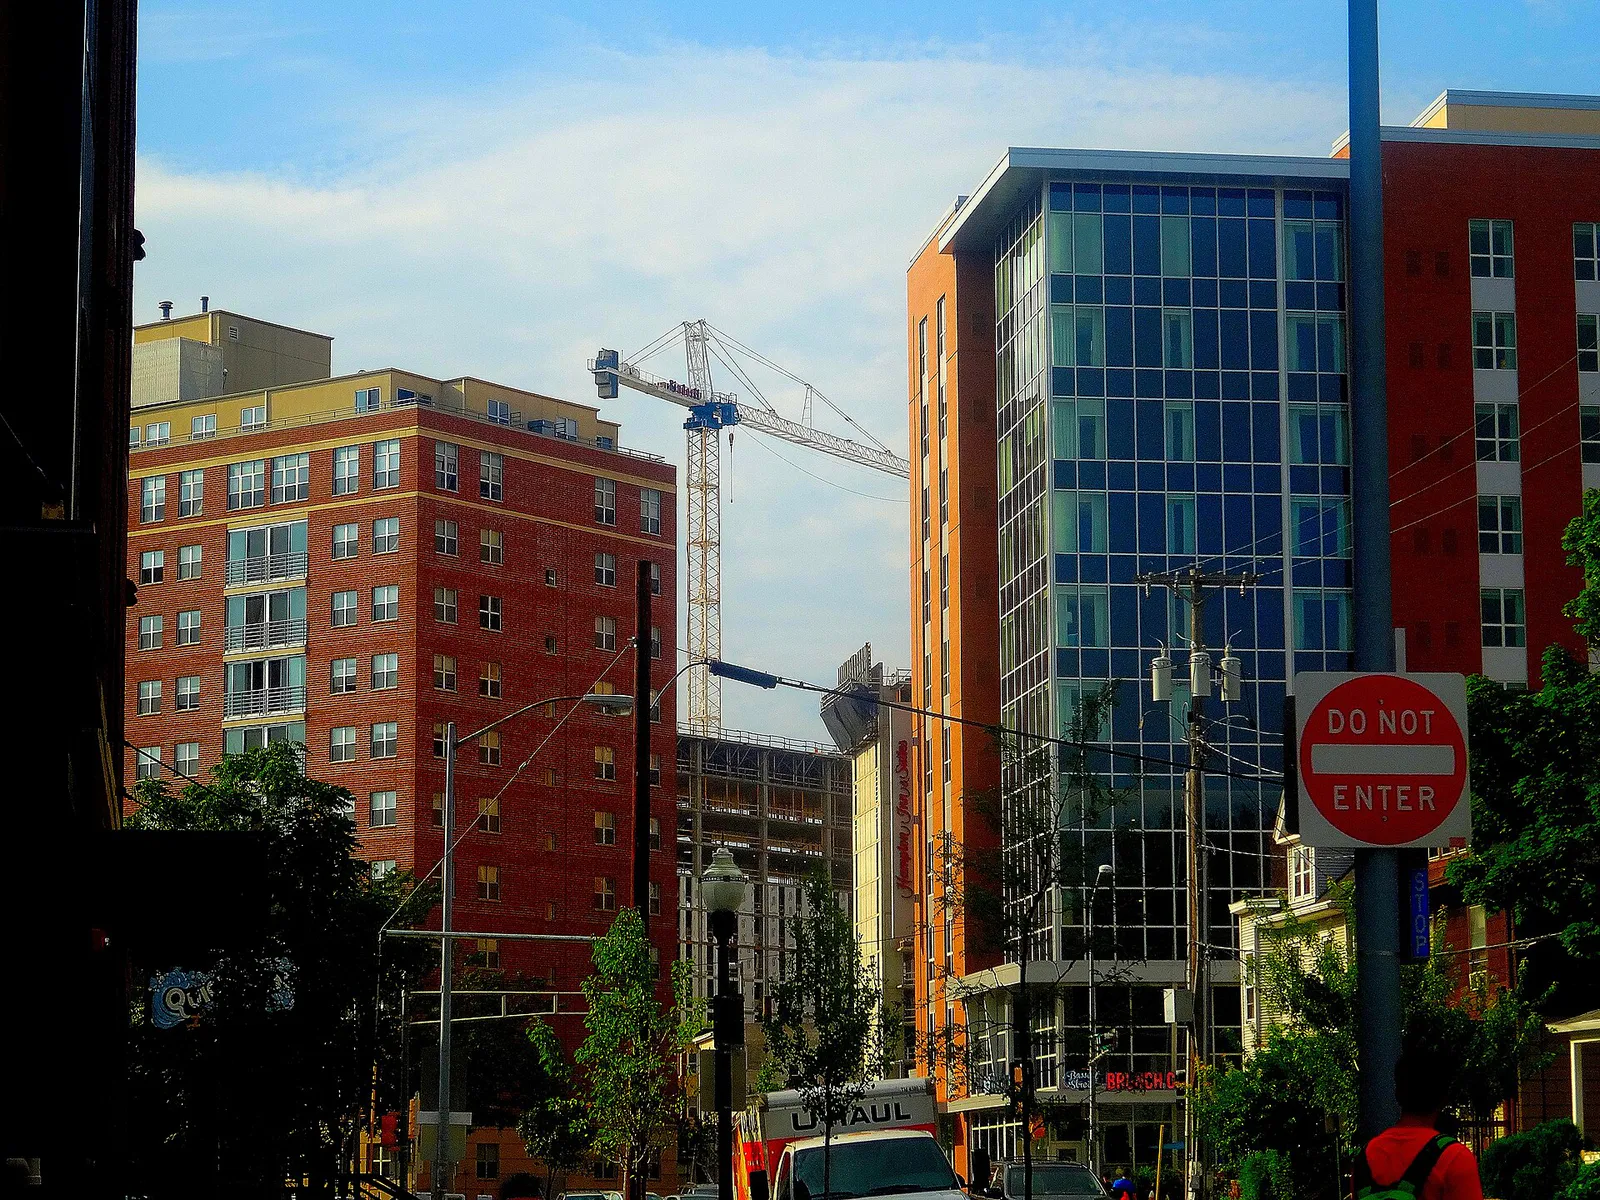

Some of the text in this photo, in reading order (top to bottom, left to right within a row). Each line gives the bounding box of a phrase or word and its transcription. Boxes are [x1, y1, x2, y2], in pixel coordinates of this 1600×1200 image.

[1327, 708, 1435, 735] DO NOT
[1333, 785, 1436, 811] ENTER
[896, 825, 914, 898] Hampton
[1412, 872, 1428, 954] STOP
[791, 1101, 912, 1131] UAUL
